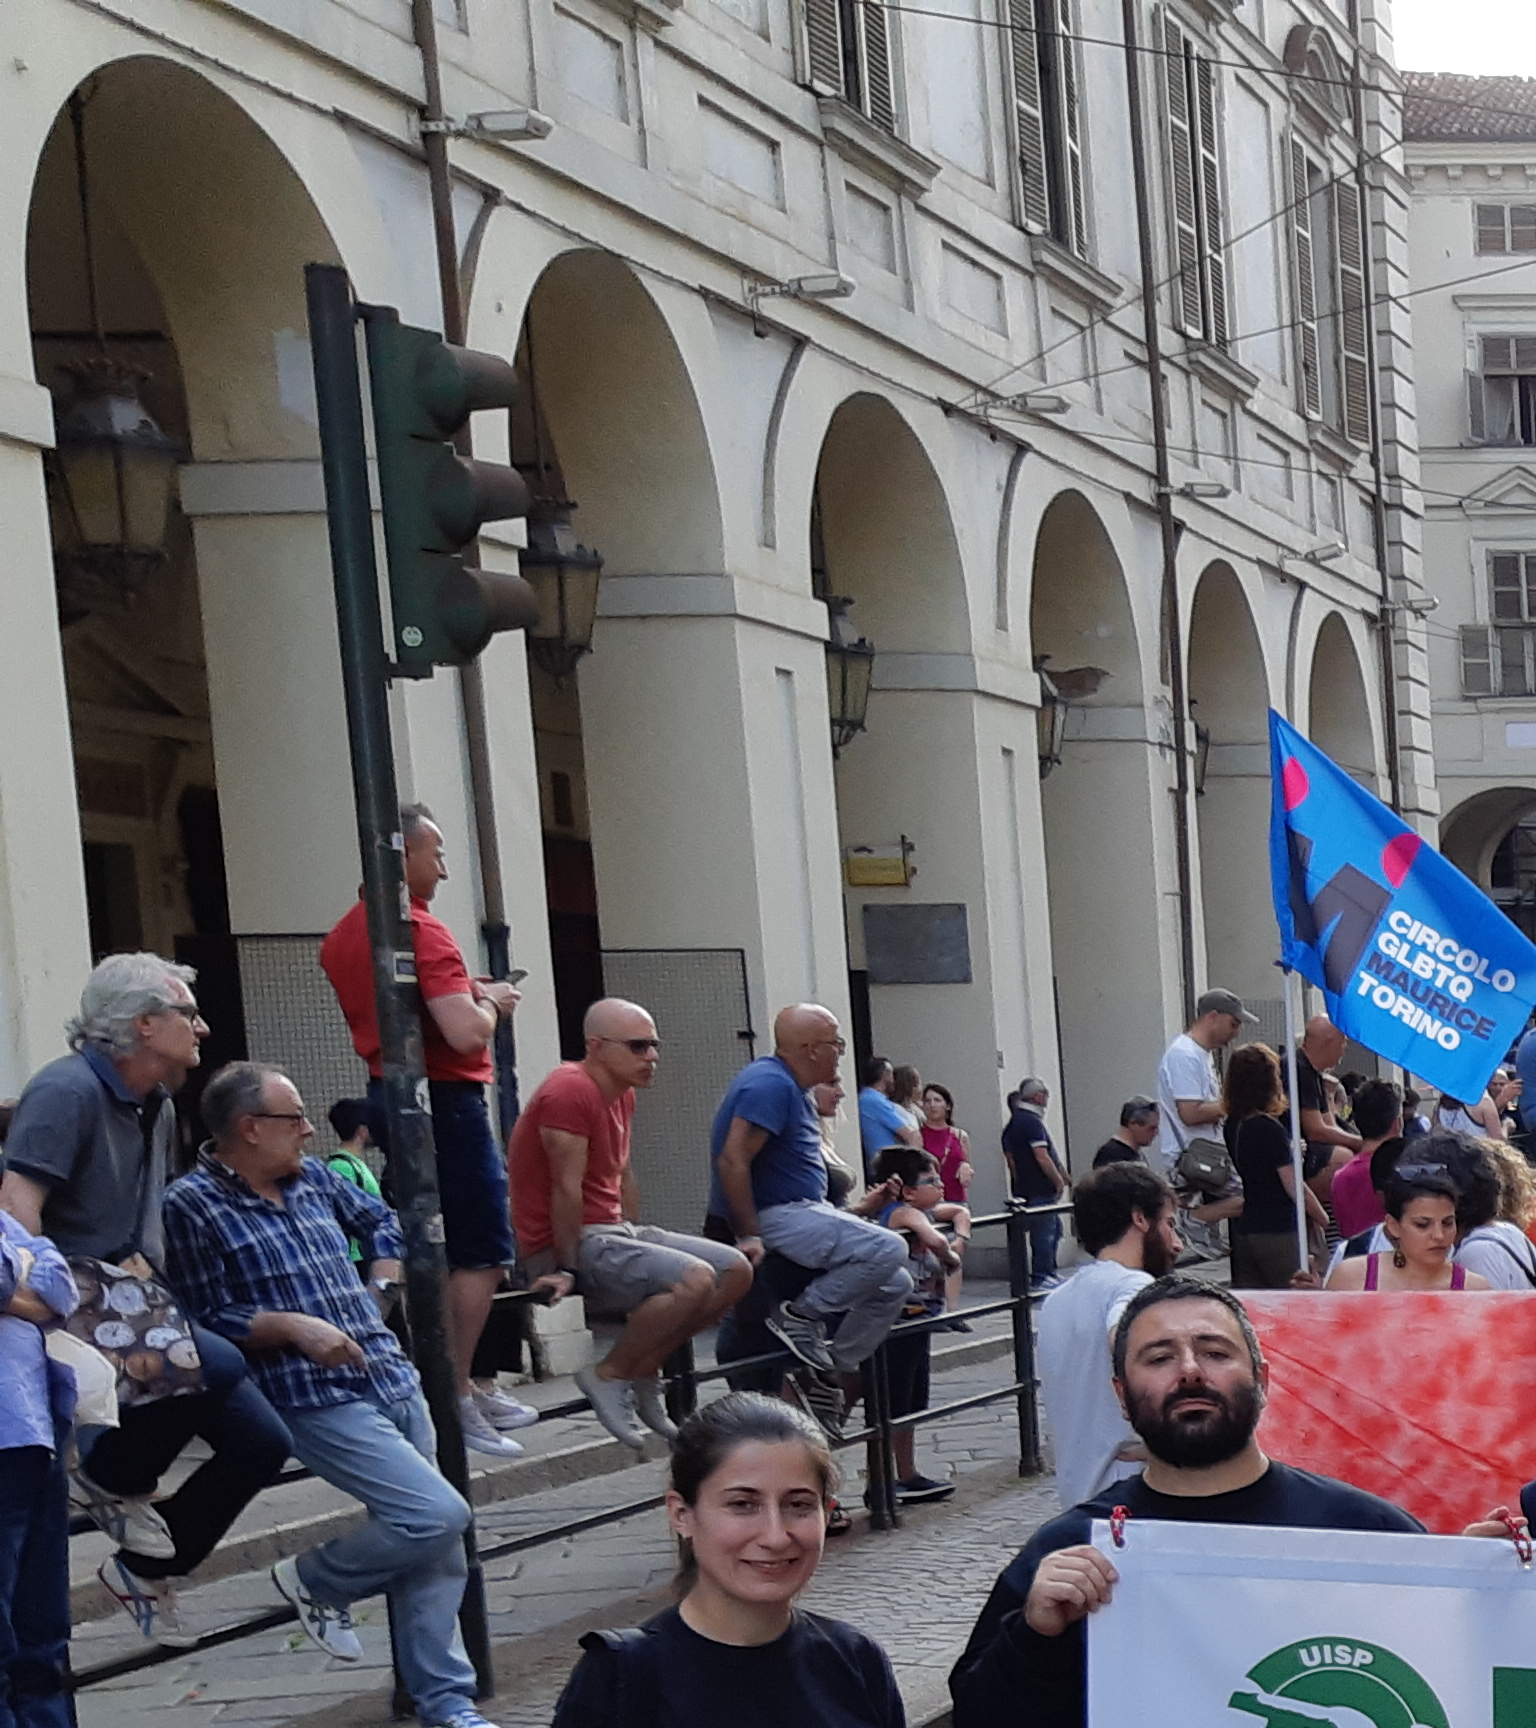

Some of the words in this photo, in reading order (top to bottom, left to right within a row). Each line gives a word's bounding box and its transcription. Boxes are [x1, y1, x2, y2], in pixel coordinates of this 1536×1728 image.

[1377, 931, 1474, 1003] GLBTQ
[1388, 910, 1516, 992] CIRCOLO
[1357, 971, 1461, 1050] TORINO
[1365, 951, 1497, 1041] MAURICE
[1299, 1643, 1374, 1669] UISP
